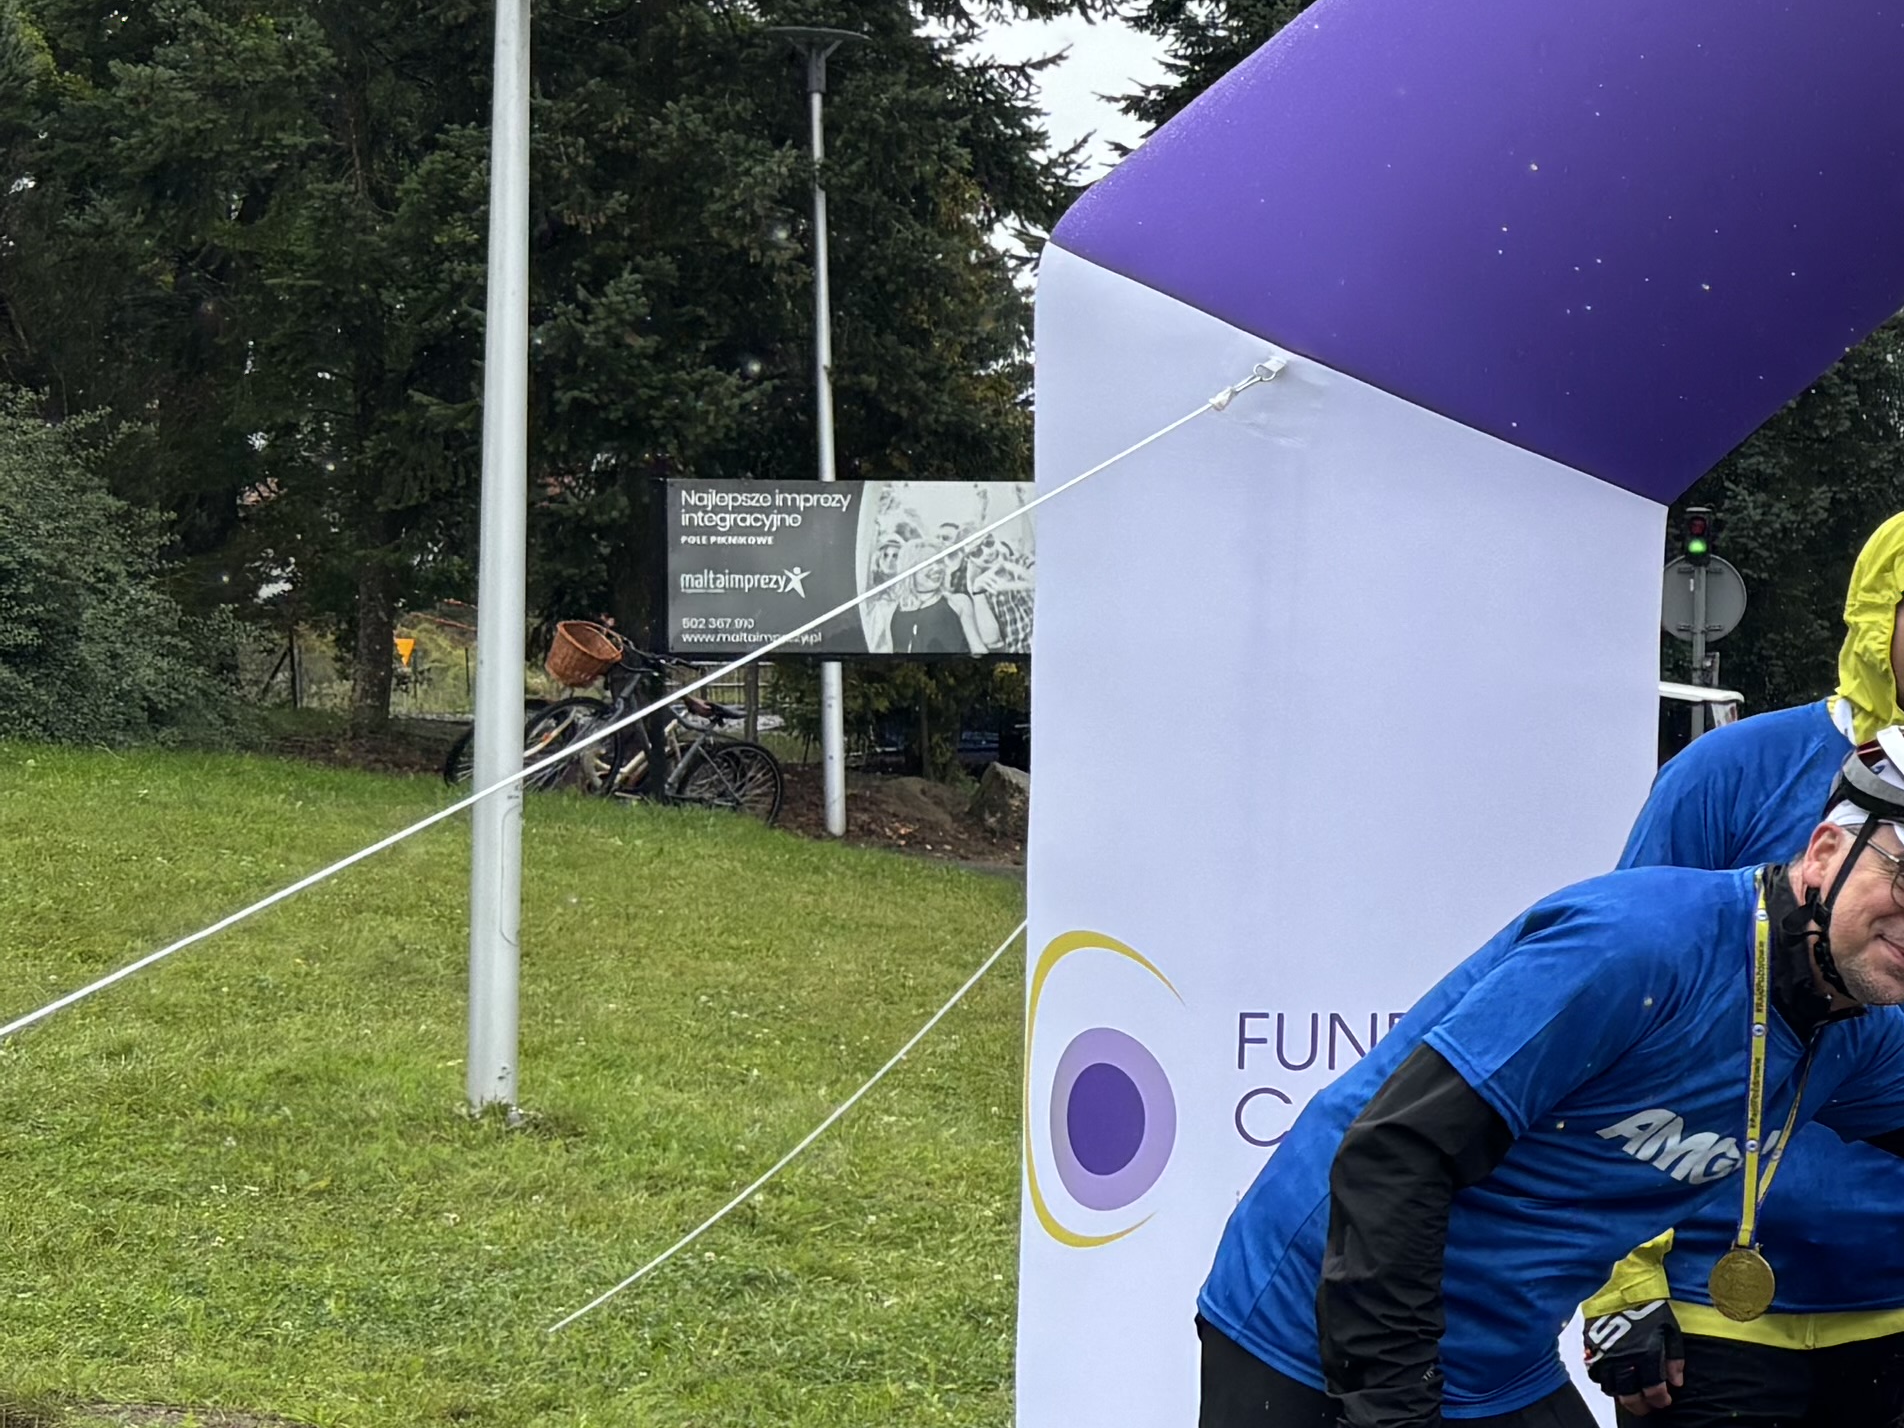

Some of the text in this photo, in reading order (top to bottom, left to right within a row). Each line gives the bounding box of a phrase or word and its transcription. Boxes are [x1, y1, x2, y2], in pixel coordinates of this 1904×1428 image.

[681, 489, 852, 512] Najlepsze imprezy
[681, 509, 803, 532] integracyjne
[680, 569, 787, 593] maltaimprezy
